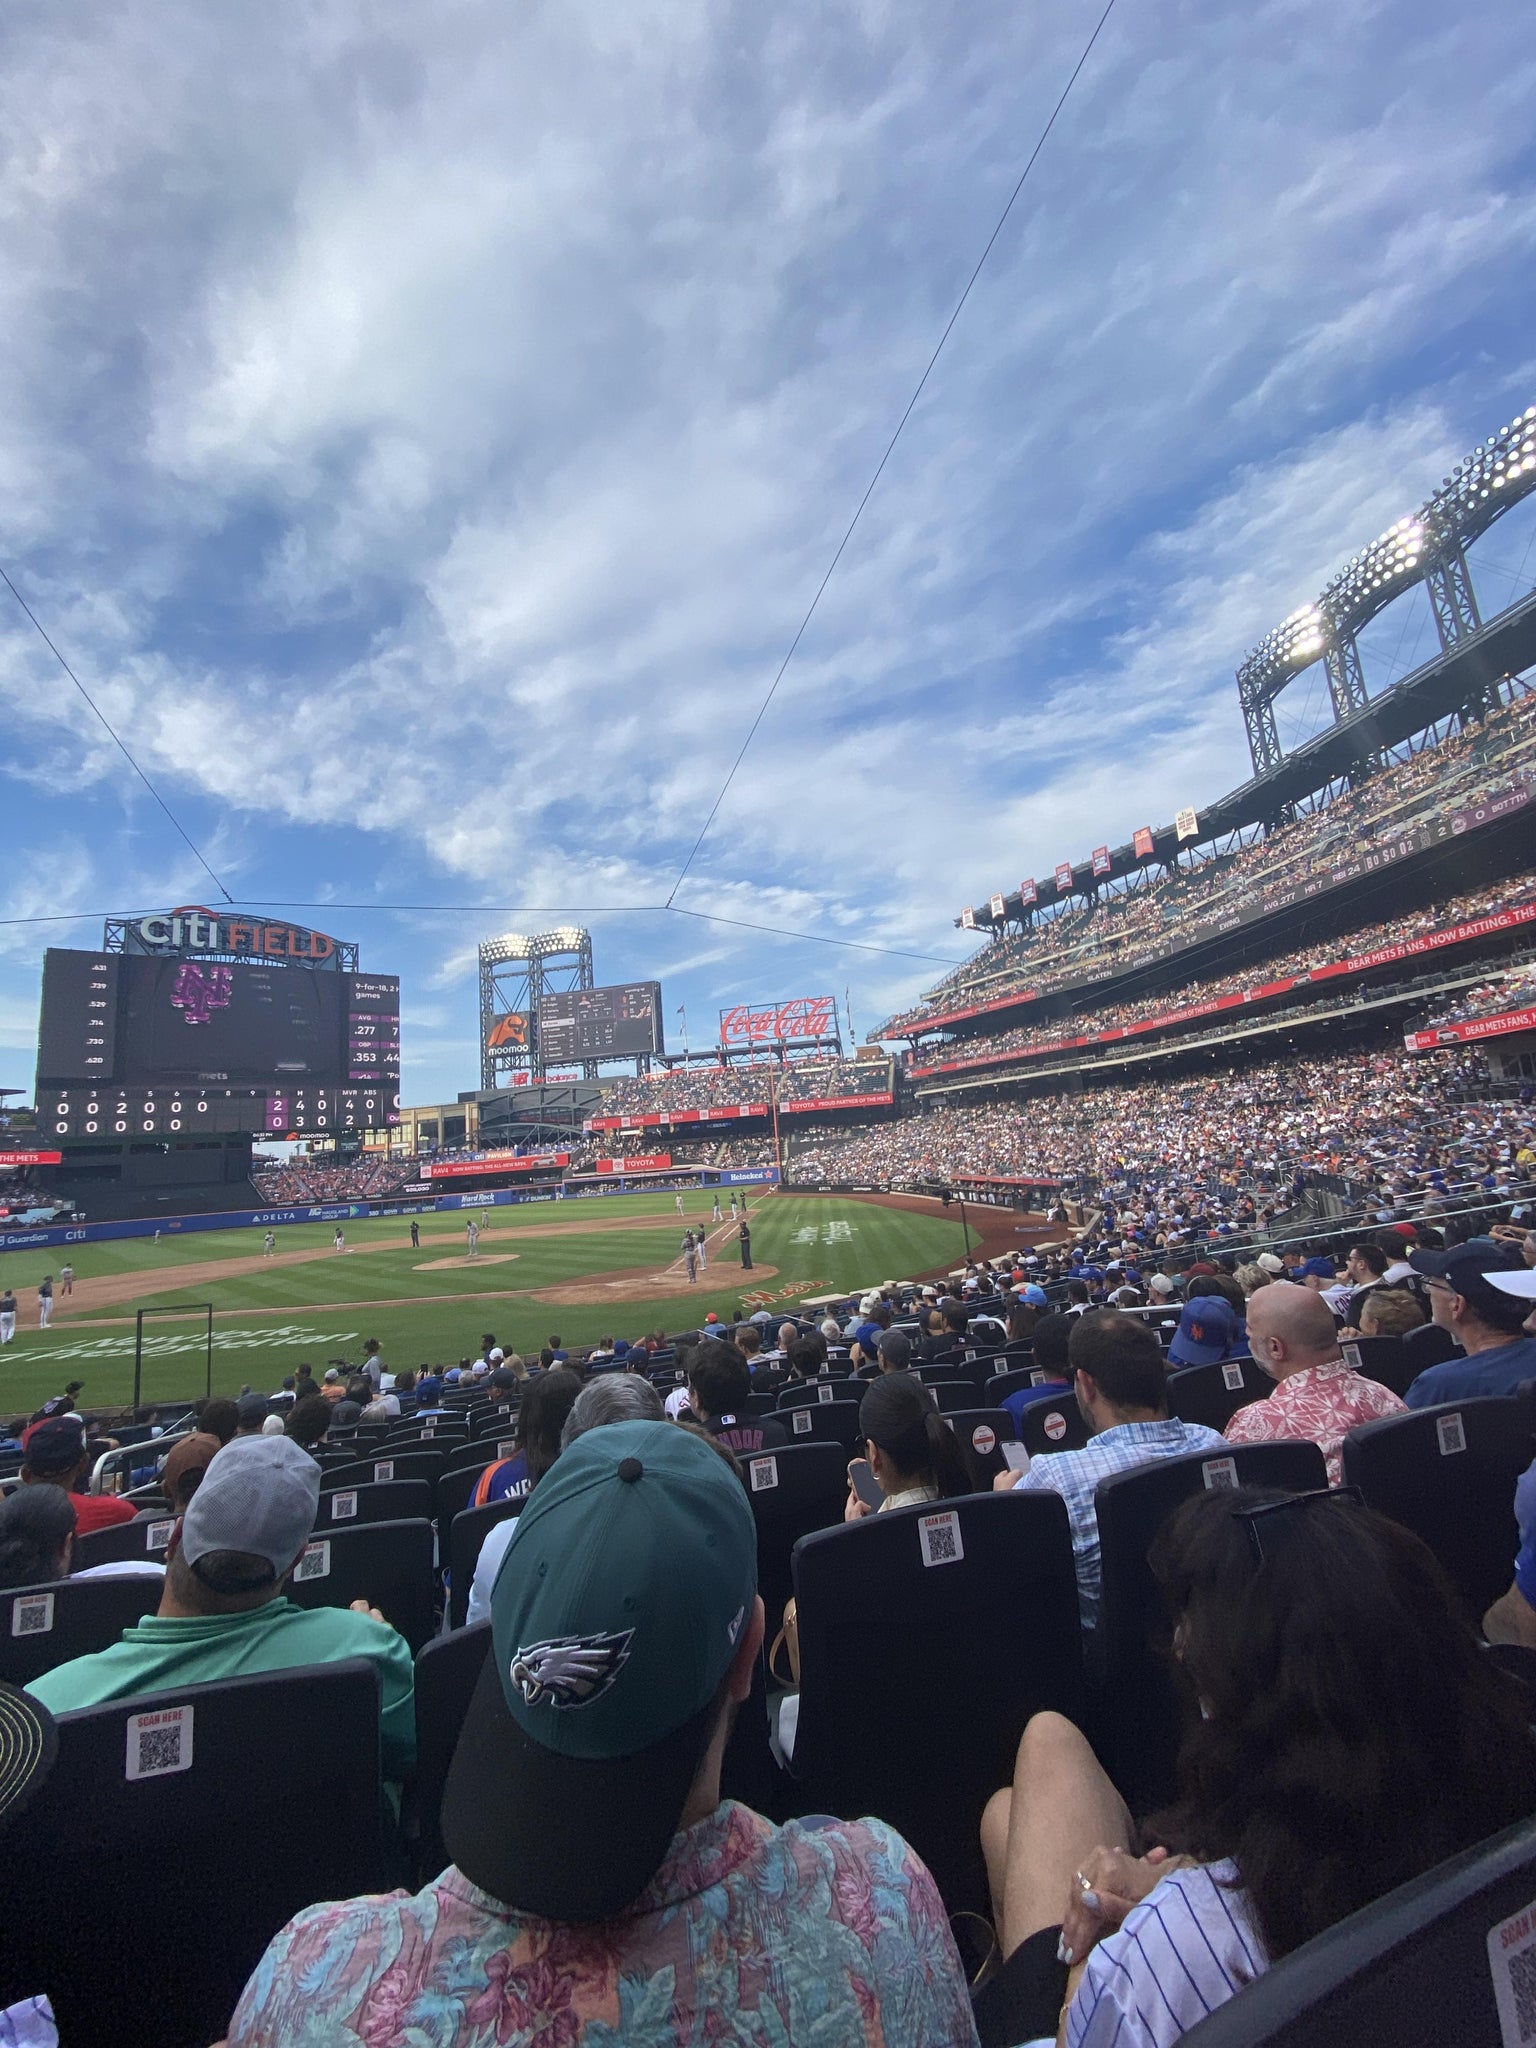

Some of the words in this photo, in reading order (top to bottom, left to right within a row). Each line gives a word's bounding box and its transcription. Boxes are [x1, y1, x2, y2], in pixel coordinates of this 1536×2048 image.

[1438, 826, 1446, 836] 2
[1491, 802, 1508, 813] BOT
[1510, 792, 1527, 805] 7TH
[1263, 900, 1279, 911] AVG
[1304, 884, 1316, 894] HR
[1316, 880, 1323, 888] 7
[1332, 869, 1346, 882] RBI
[1347, 864, 1361, 875] 24
[1219, 917, 1240, 931] EWING
[140, 912, 218, 949] citi
[229, 923, 334, 959] FIELD
[1347, 956, 1371, 970] DEAR
[1372, 950, 1396, 966] METS
[1397, 939, 1428, 956] FANS,
[1429, 930, 1457, 945] NOW
[1459, 916, 1511, 938] BATTING:
[1513, 907, 1536, 922] THE
[355, 983, 389, 992] 9-for-18,
[355, 992, 380, 1000] games
[1153, 1016, 1167, 1026] PROUD
[1167, 1012, 1188, 1023] PARTNER
[1194, 1007, 1204, 1016] THE
[1203, 1002, 1218, 1013] METS
[1465, 1023, 1485, 1036] DEAR
[1485, 1019, 1506, 1033] METS
[1507, 1014, 1531, 1029] FANS,
[355, 1026, 375, 1035] .277
[392, 1027, 398, 1035] 7
[488, 1044, 529, 1056] moomoo
[353, 1053, 376, 1062] .353
[547, 1074, 578, 1083] balance
[57, 1103, 69, 1115] 0
[87, 1103, 99, 1114] 0
[116, 1103, 127, 1114] 2
[144, 1102, 155, 1113] 0
[171, 1102, 182, 1113] 0
[197, 1101, 208, 1112] 0
[274, 1101, 282, 1111] 2
[296, 1100, 305, 1110] 4
[318, 1100, 326, 1110] 0
[346, 1100, 354, 1109] 4
[366, 1099, 374, 1109] 0
[56, 1122, 68, 1133] 0
[86, 1121, 98, 1133] 0
[116, 1121, 126, 1132] 0
[143, 1120, 154, 1131] 0
[170, 1119, 181, 1130] 0
[273, 1117, 282, 1127] 0
[296, 1116, 304, 1126] 3
[317, 1116, 326, 1126] 0
[346, 1115, 354, 1125] 2
[16, 1154, 39, 1162] METS
[627, 1159, 654, 1168] TOYOTA
[433, 1167, 449, 1175] RAV4
[731, 1172, 764, 1181] Heineken
[461, 1195, 476, 1203] Hard
[478, 1193, 495, 1201] Rock
[262, 1212, 295, 1221] DELTA
[7, 1234, 48, 1244] Guardian
[924, 1518, 939, 1527] SCAN
[138, 1714, 160, 1728] SCAN
[162, 1709, 183, 1723] HERE
[1500, 1914, 1530, 1949] SCAN
